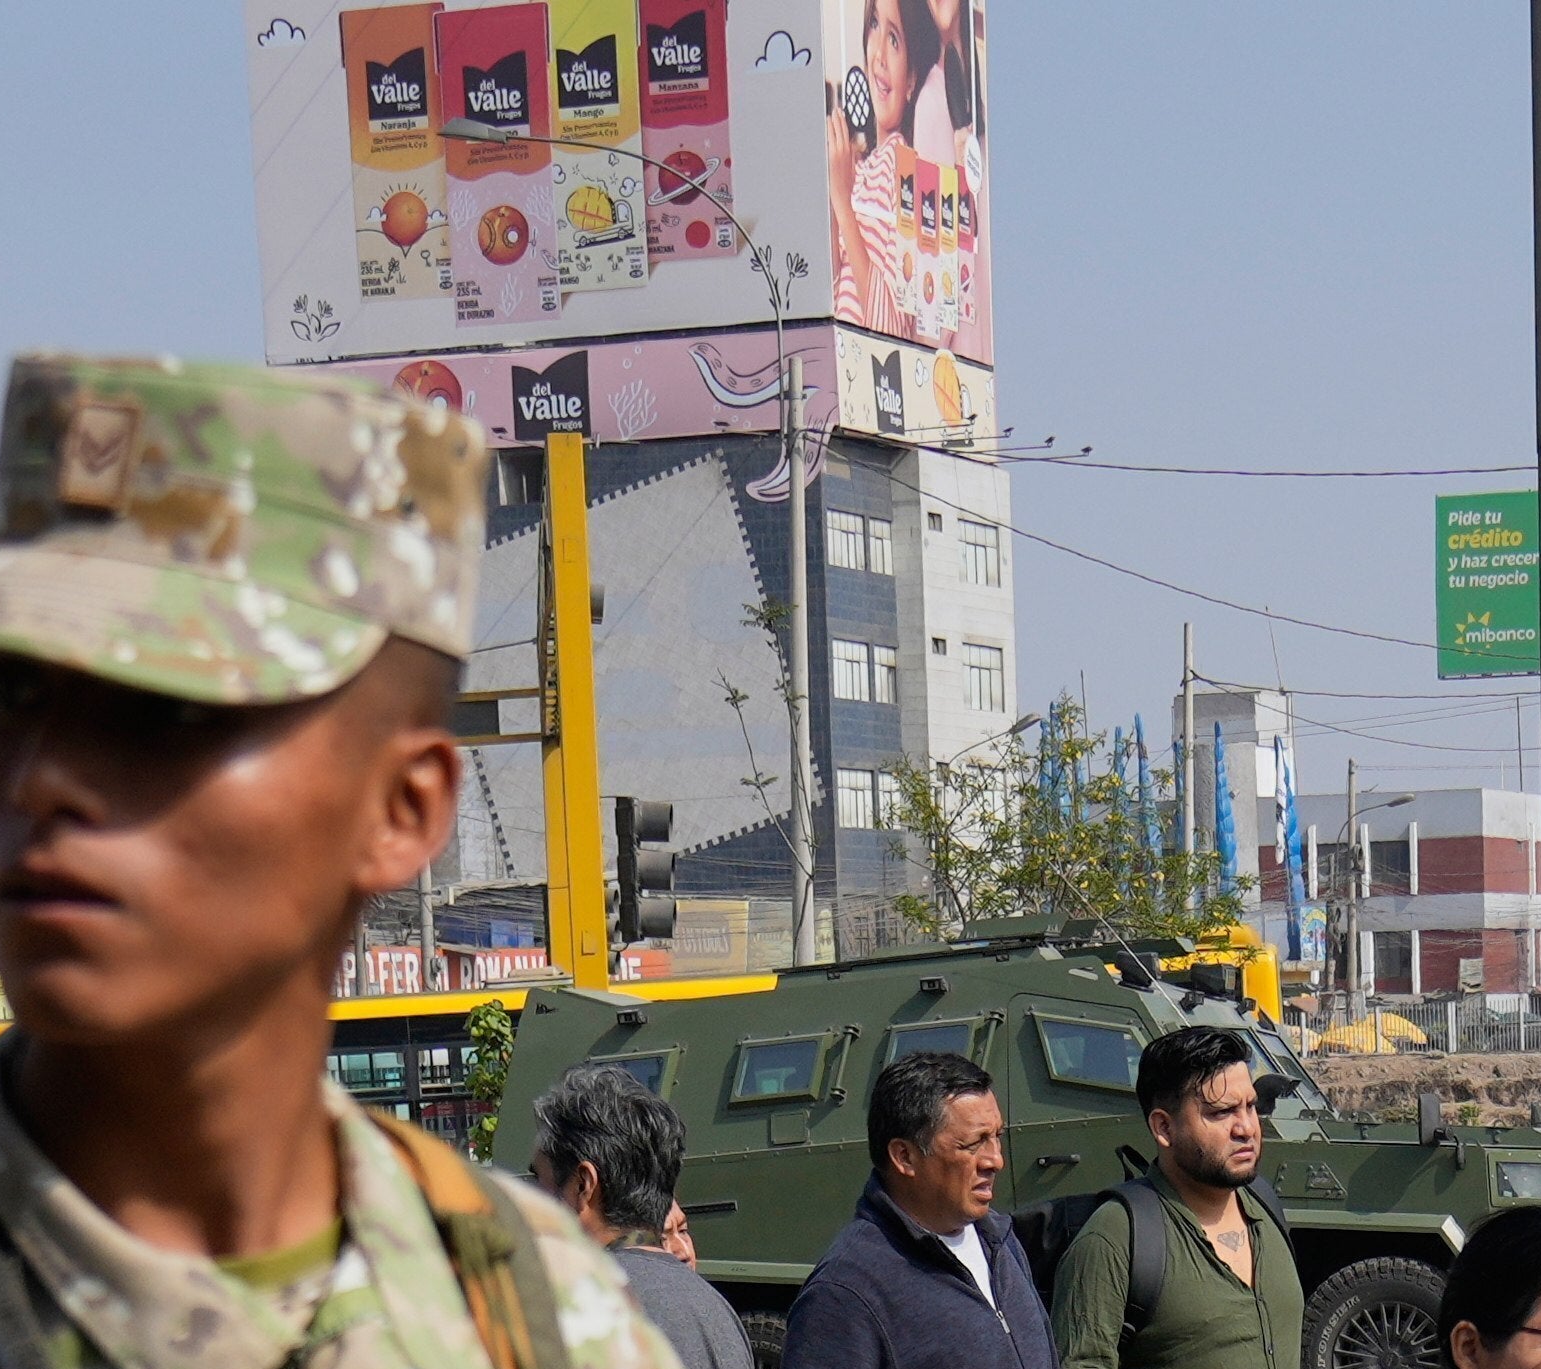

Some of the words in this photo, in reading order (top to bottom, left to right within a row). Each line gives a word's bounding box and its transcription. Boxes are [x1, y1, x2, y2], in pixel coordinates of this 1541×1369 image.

[662, 35, 677, 47] del
[651, 44, 702, 66] Valle
[572, 60, 587, 72] del
[382, 74, 396, 84] del
[480, 79, 495, 91] del
[561, 70, 612, 92] Valle
[372, 82, 420, 104] Valle
[658, 82, 699, 92] Manzana
[469, 89, 521, 112] Valle
[574, 108, 604, 119] Mango
[381, 119, 416, 131] Naranja
[456, 287, 470, 297] 235
[532, 382, 552, 396] del
[518, 394, 582, 420] Valle
[1448, 510, 1481, 526] Pide
[1485, 511, 1502, 525] tu
[1448, 528, 1523, 550] crédito
[1447, 556, 1458, 571] y
[1461, 553, 1488, 569] haz
[1492, 551, 1539, 566] crecer
[1449, 574, 1465, 588] tu
[1470, 570, 1529, 589] negocio
[1466, 628, 1536, 643] mibanco
